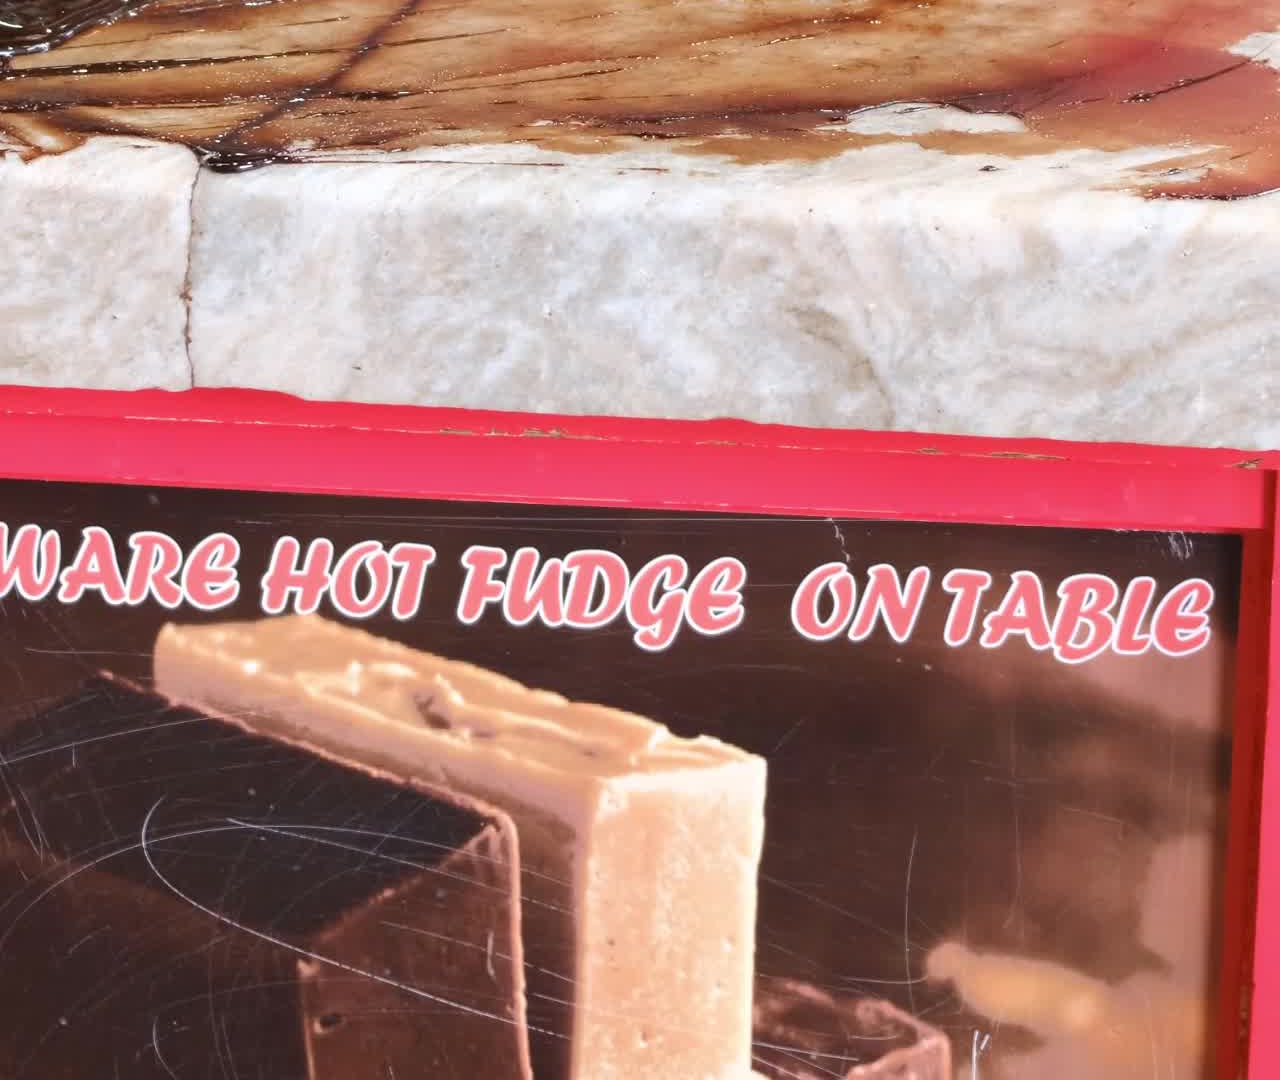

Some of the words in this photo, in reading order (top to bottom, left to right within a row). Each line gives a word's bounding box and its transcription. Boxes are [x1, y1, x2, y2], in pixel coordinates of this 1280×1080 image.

[260, 535, 436, 619] HOT
[457, 546, 748, 652] FUDGE
[790, 561, 932, 644] ON
[941, 568, 1216, 664] TABLE
